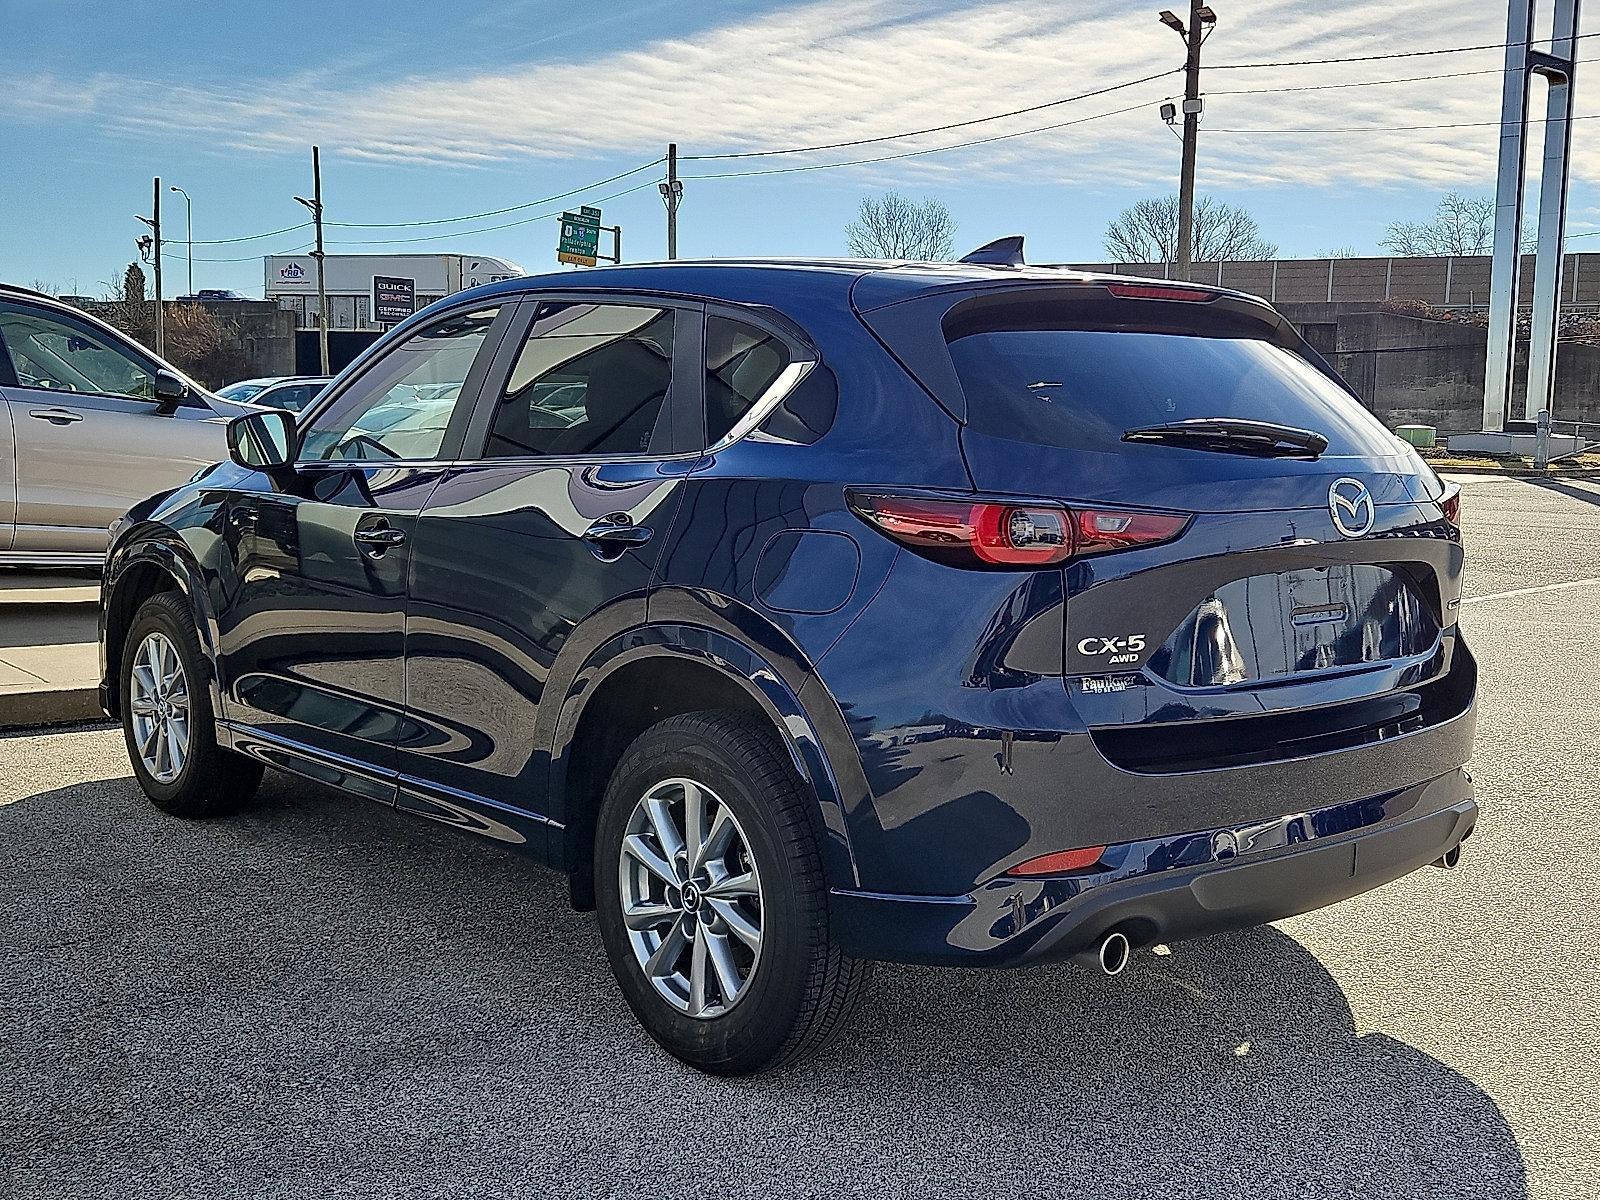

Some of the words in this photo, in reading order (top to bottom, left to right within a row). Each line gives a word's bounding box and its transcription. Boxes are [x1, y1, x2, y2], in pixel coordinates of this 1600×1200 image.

[562, 236, 591, 247] Philadelphia
[378, 283, 412, 291] BUICK
[380, 293, 411, 302] GMC
[1077, 634, 1146, 655] CX-5
[1108, 653, 1139, 664] AWD
[1081, 675, 1136, 691] Faulkner
